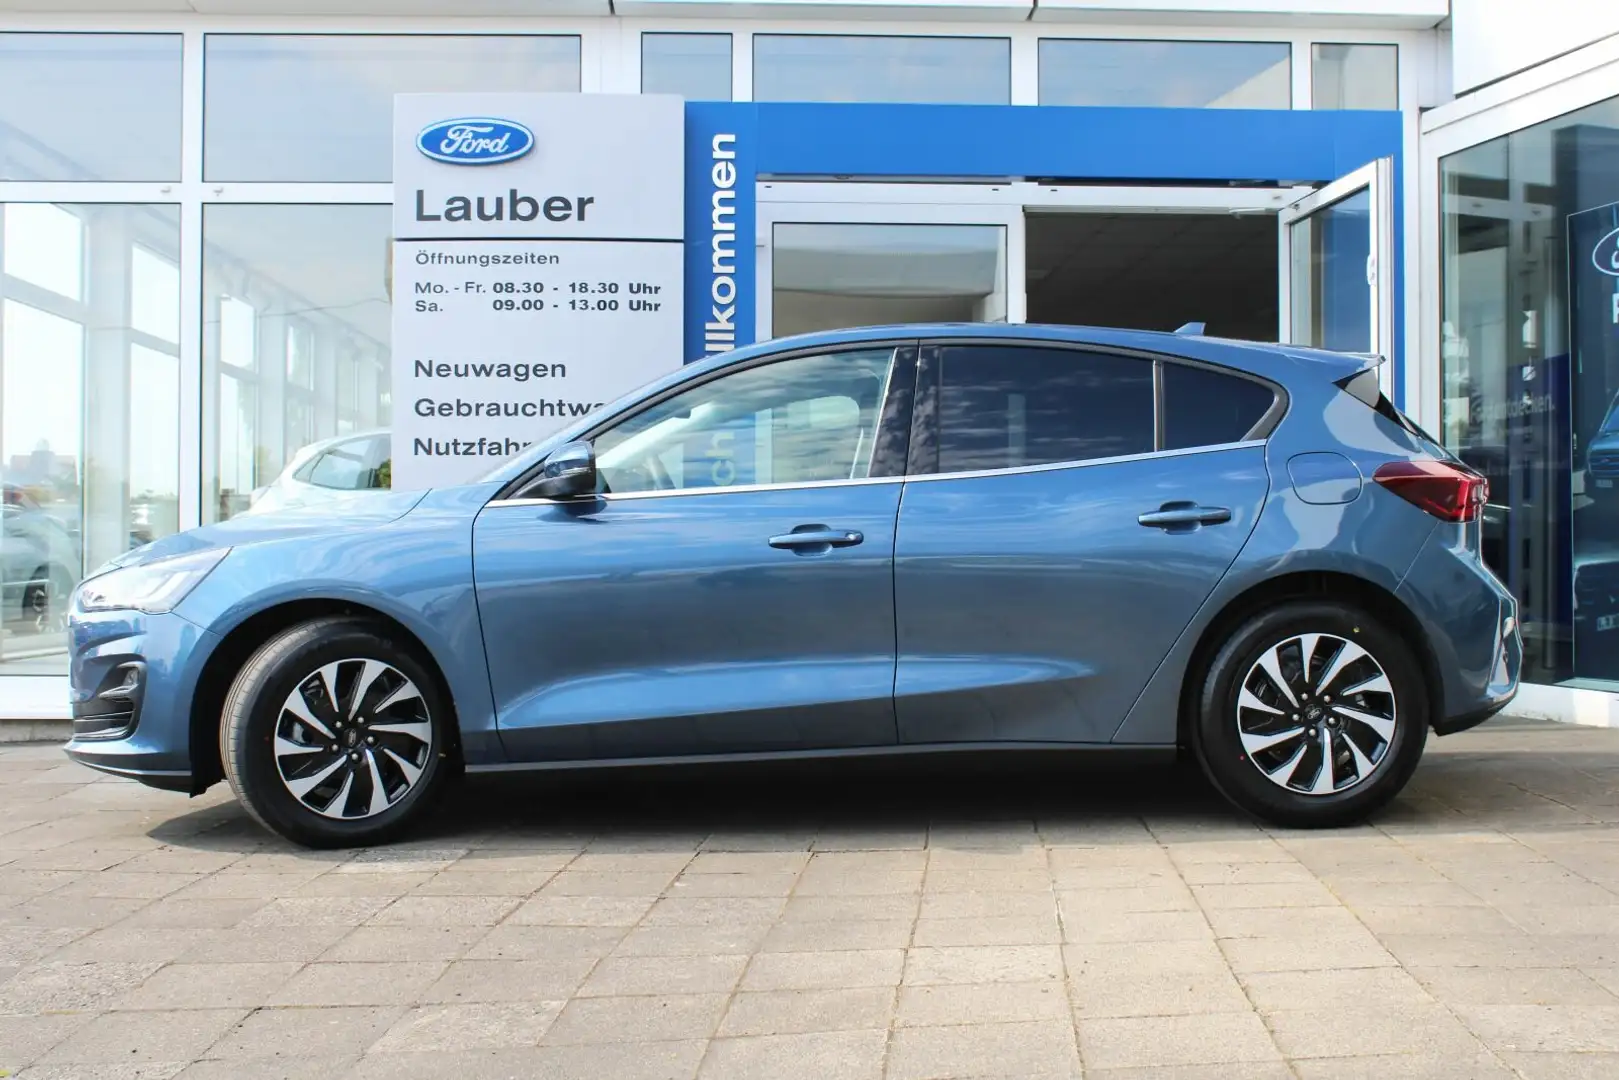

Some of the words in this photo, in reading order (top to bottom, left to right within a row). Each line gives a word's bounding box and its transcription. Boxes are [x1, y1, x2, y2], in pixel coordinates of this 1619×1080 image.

[440, 125, 511, 154] Ford
[415, 188, 595, 223] Lauber
[415, 250, 560, 268] Öffnungszeiten
[414, 282, 449, 295] Mo.
[464, 281, 487, 294] Fr.
[492, 281, 545, 295] 08.30
[567, 281, 620, 295] 18.30
[628, 282, 663, 296] Uhr
[415, 299, 444, 313] Sa.
[492, 298, 545, 312] 09.00
[567, 298, 620, 312] 13.00
[628, 299, 663, 313] Uhr
[414, 359, 567, 382] Neuwagen
